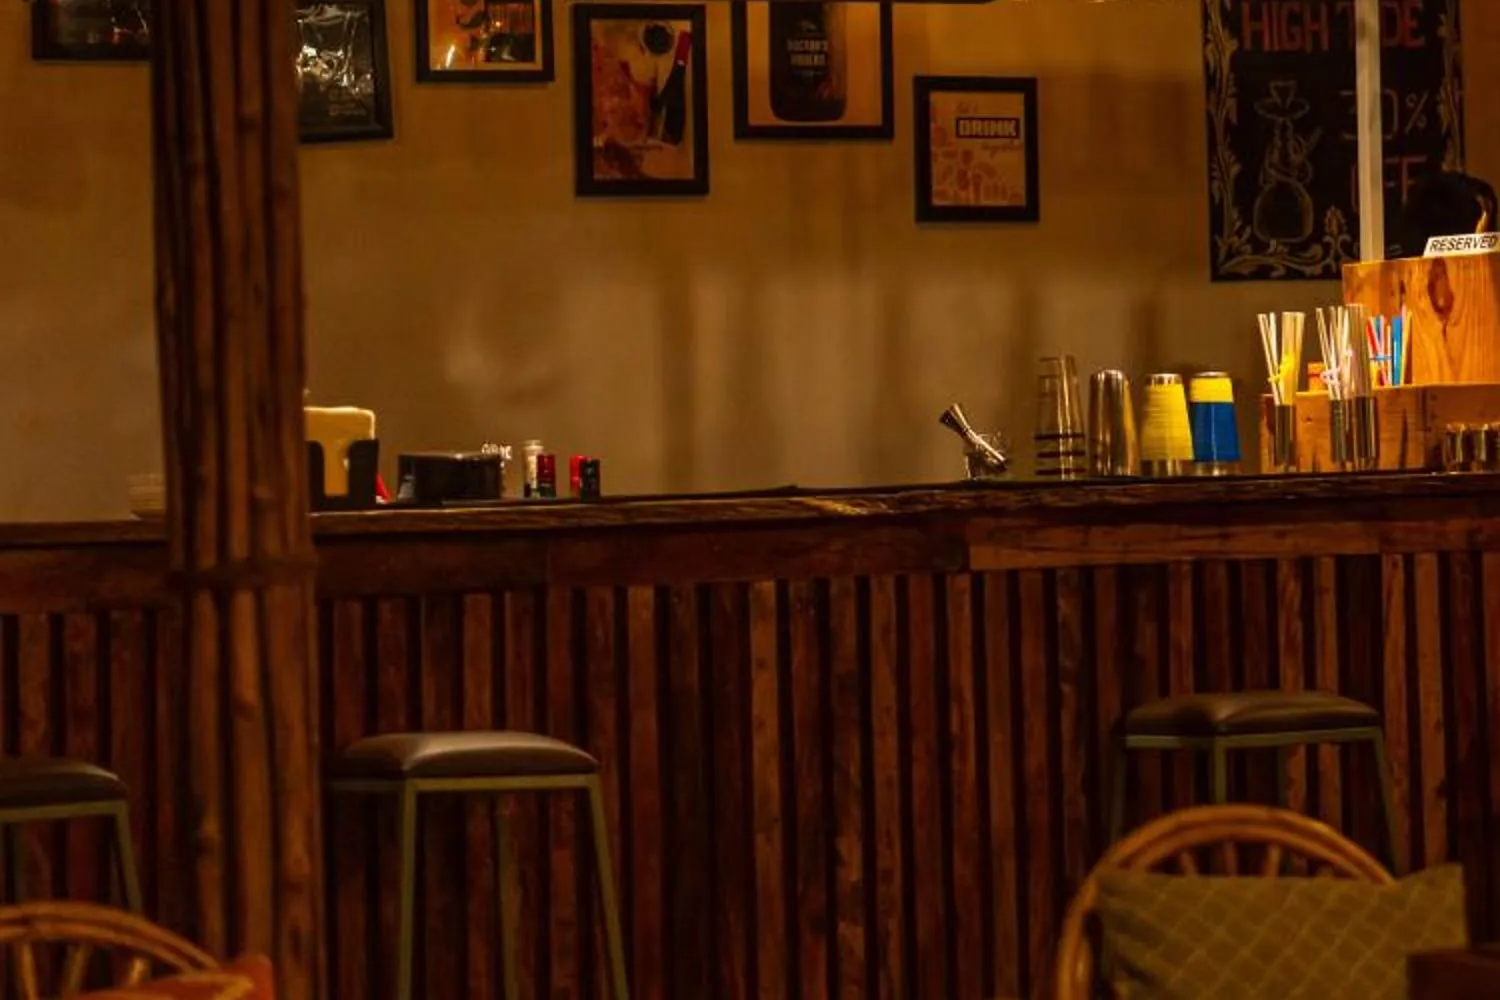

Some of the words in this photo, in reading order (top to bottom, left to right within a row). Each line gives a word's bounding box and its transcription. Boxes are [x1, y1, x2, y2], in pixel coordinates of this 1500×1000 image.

[1242, 0, 1330, 52] HIGH
[959, 119, 1018, 137] DRINK
[1429, 234, 1498, 253] RESERVED
